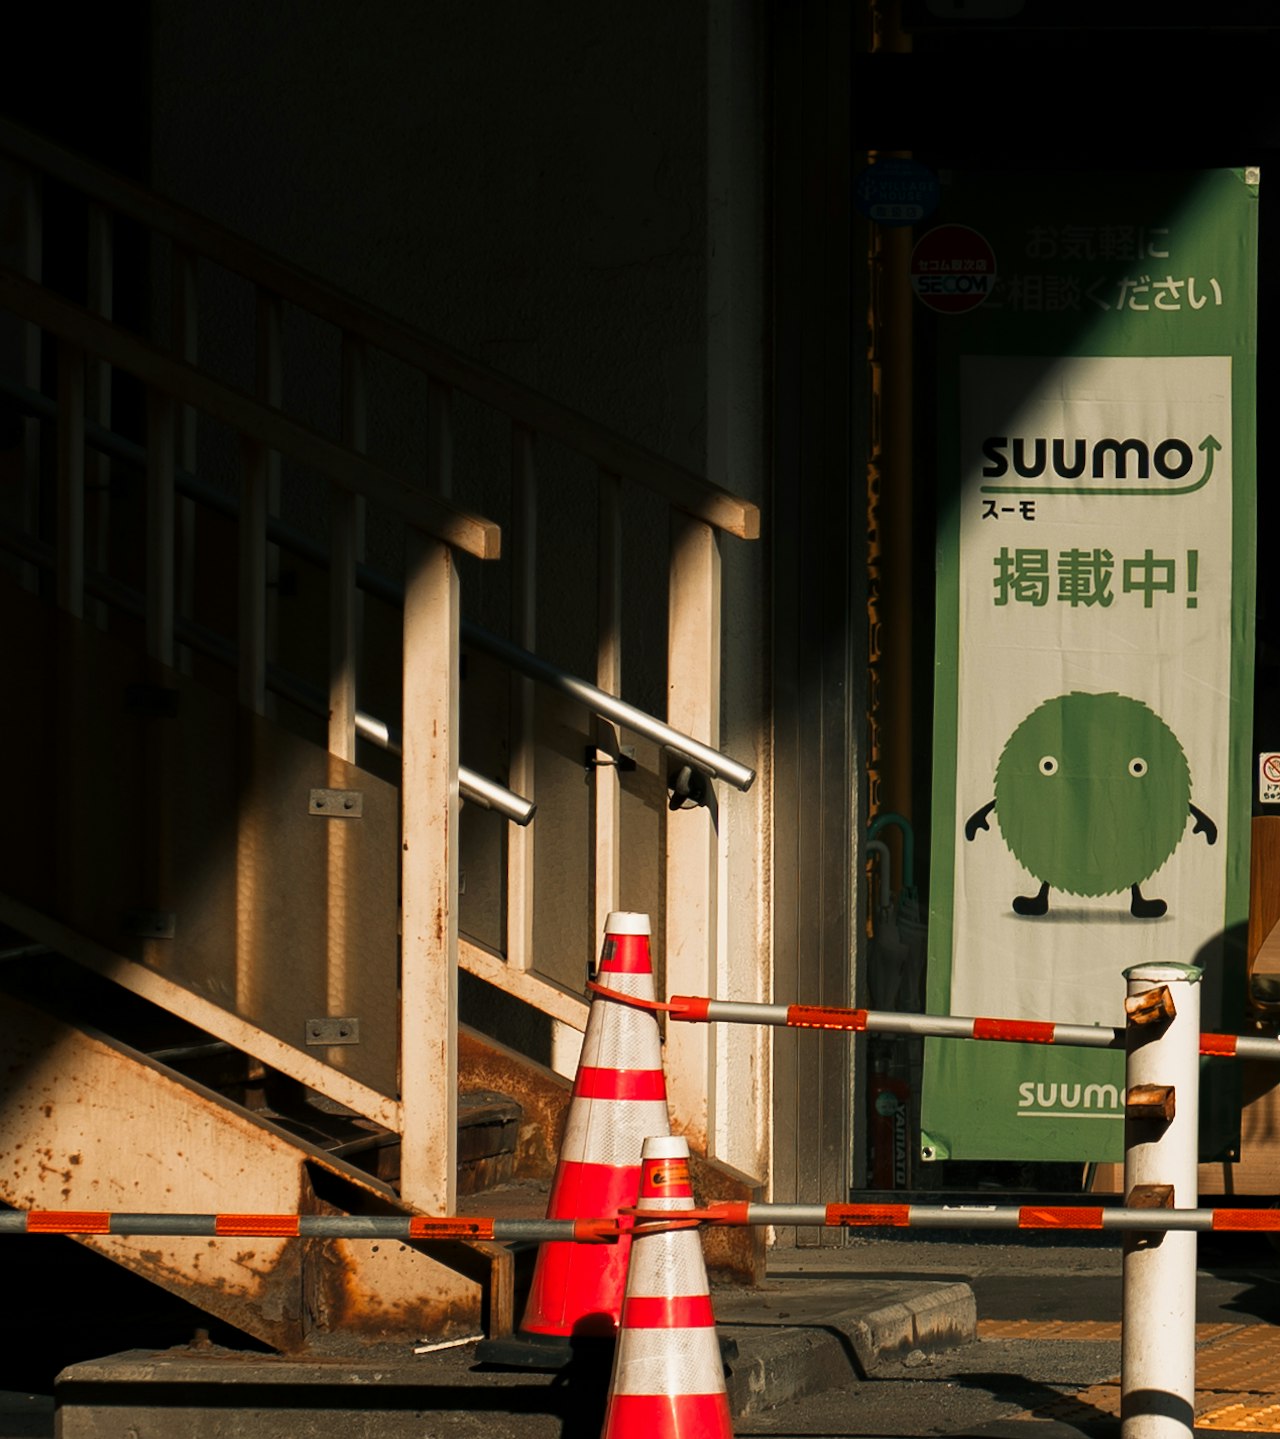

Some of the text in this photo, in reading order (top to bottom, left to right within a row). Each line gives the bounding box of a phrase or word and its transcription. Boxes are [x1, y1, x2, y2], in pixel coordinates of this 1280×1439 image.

[1024, 224, 1169, 261] お気軽に
[919, 276, 987, 293] SECOM
[982, 500, 1036, 520] スーモ
